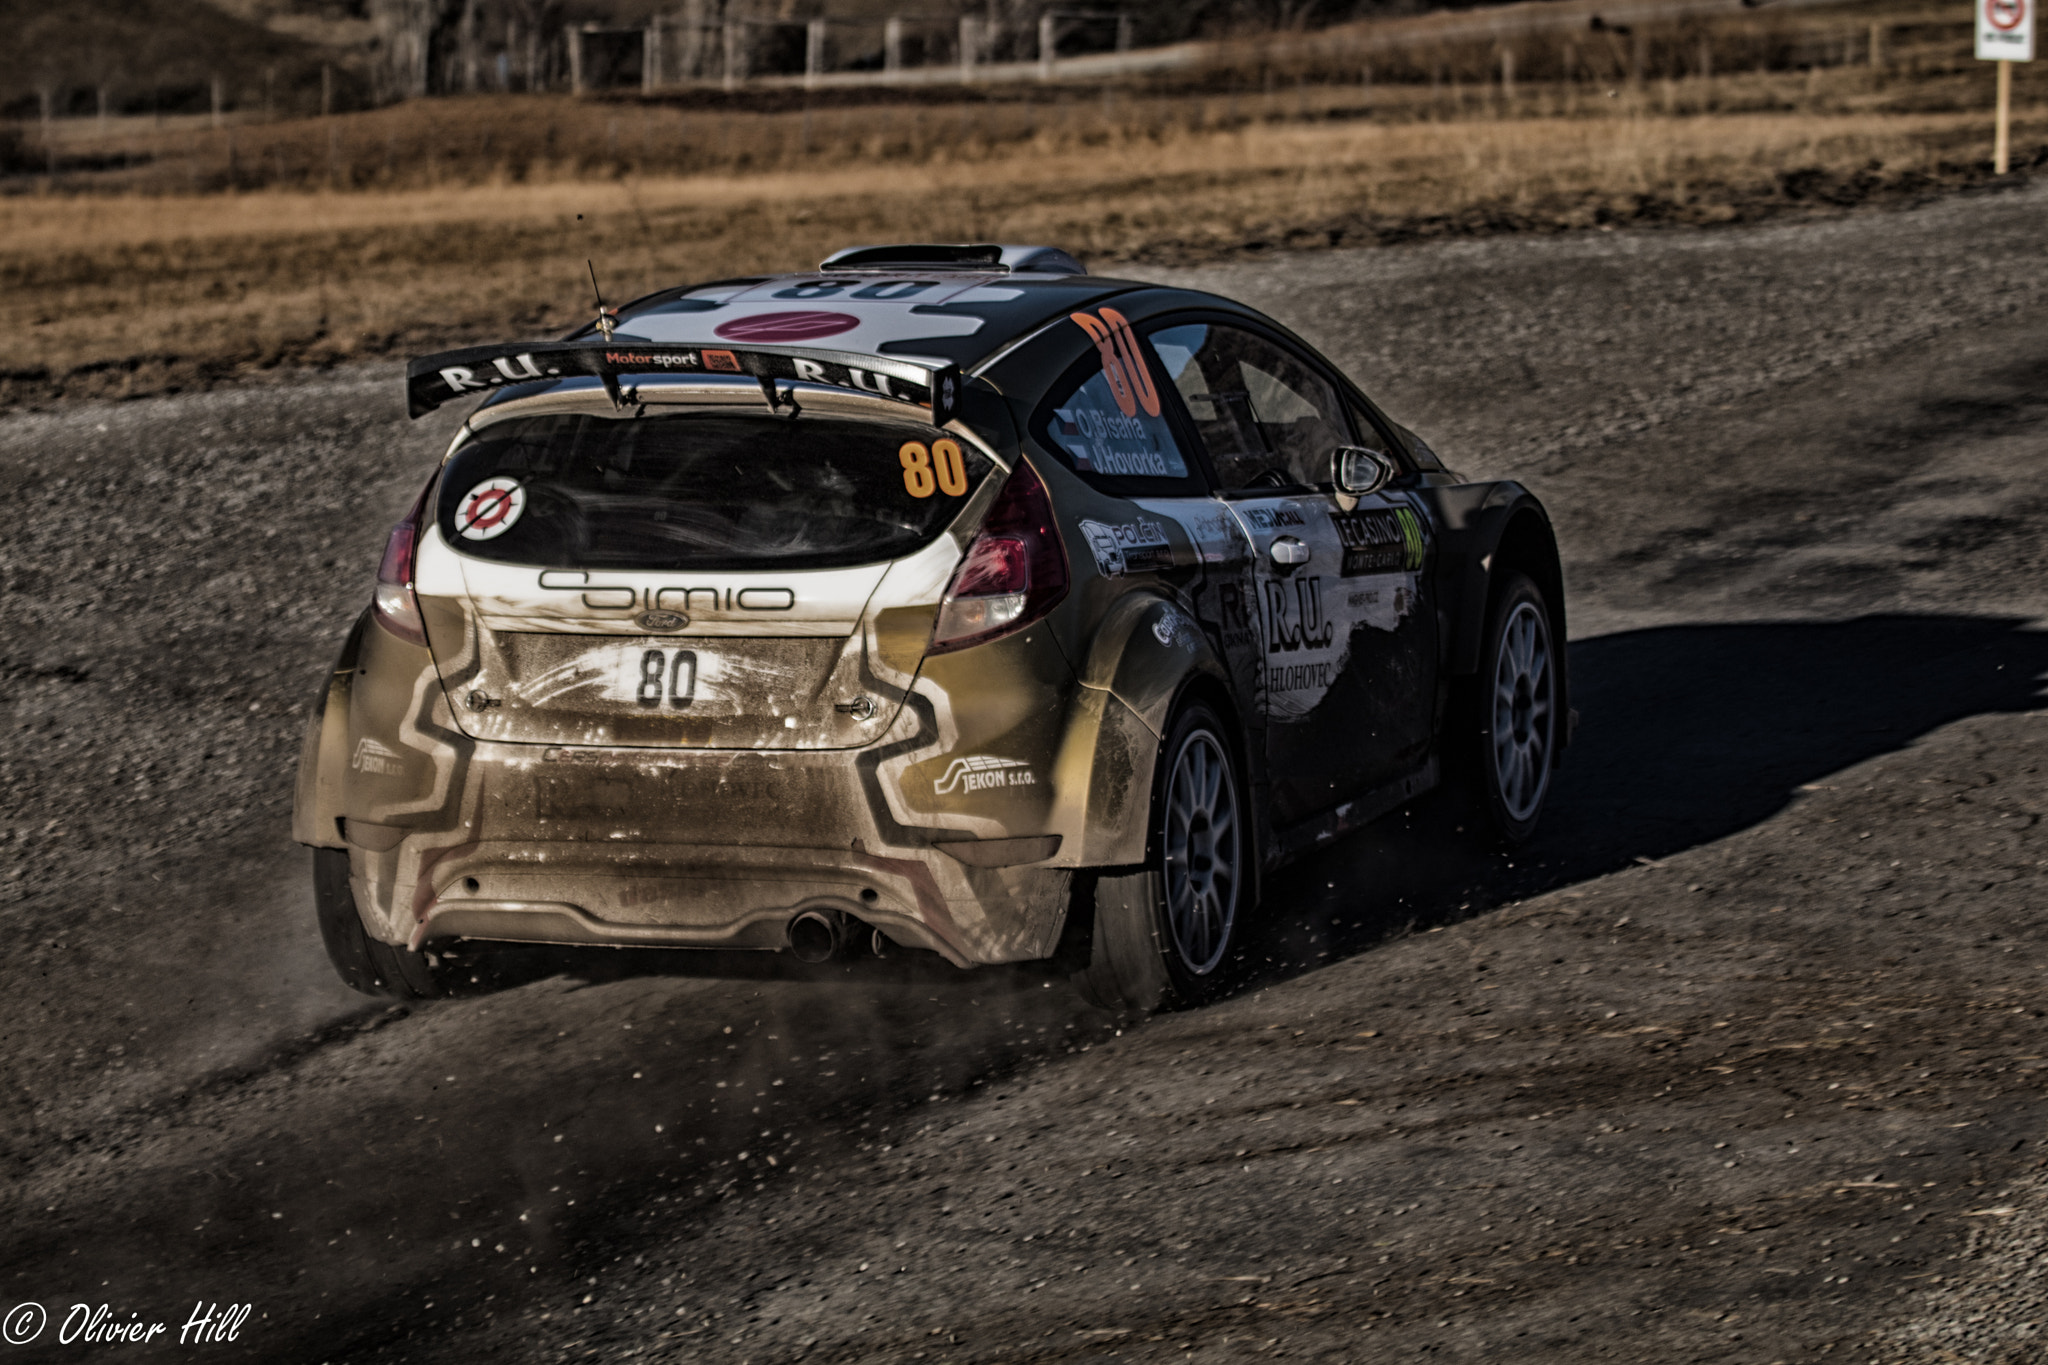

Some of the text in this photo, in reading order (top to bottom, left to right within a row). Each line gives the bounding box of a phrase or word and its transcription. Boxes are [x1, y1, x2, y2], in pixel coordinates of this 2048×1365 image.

[771, 280, 941, 300] 80
[438, 352, 560, 392] R.U.
[606, 353, 698, 368] Motorsport
[1070, 307, 1160, 418] 80
[792, 358, 911, 400] R.U.
[898, 438, 968, 498] 80
[1350, 514, 1402, 547] CASINO
[645, 614, 678, 628] Ford
[1264, 576, 1334, 653] R.U.
[636, 649, 697, 710] 80
[1269, 662, 1331, 693] HLOHOVEC
[962, 770, 1036, 795] JEKON s.r.o.
